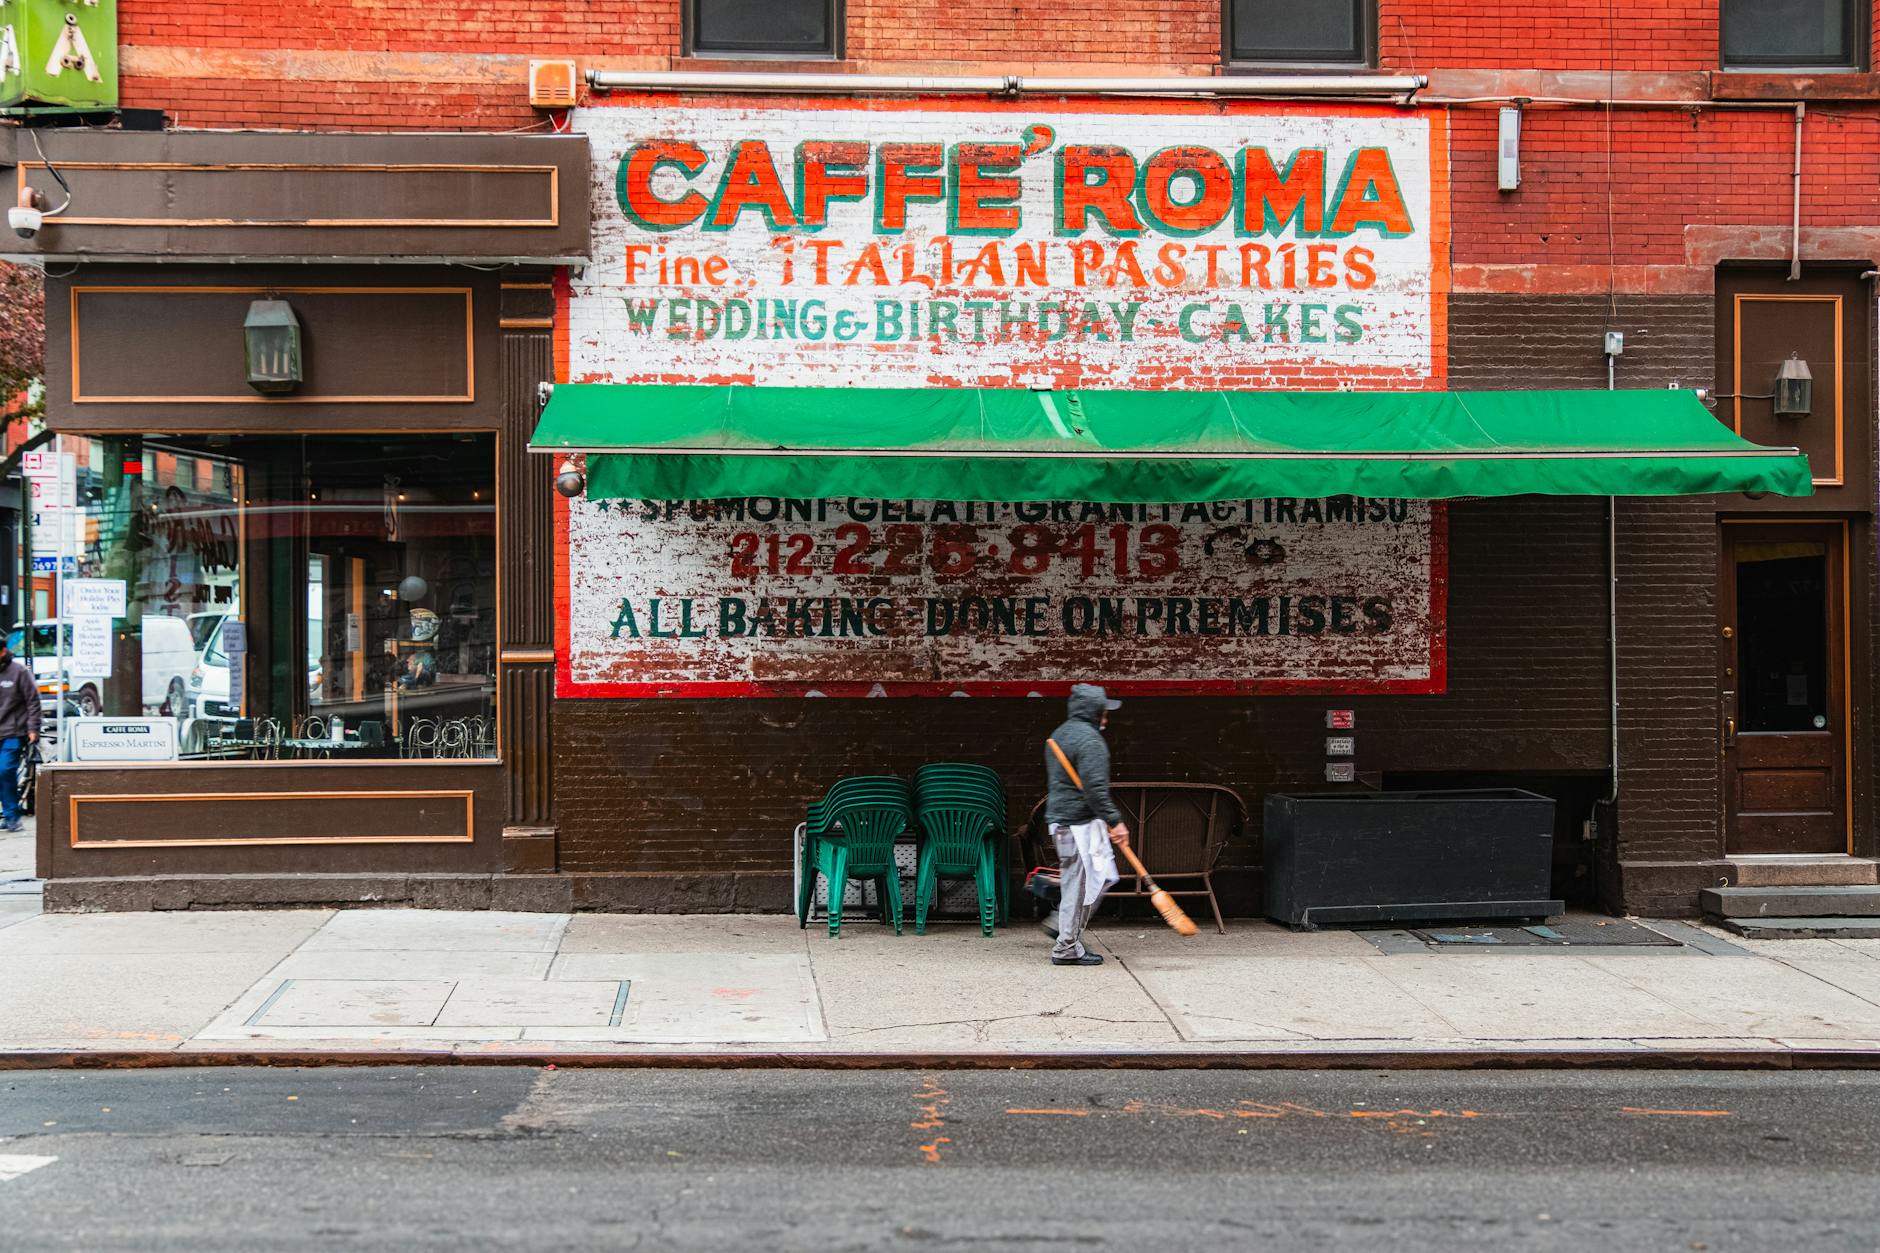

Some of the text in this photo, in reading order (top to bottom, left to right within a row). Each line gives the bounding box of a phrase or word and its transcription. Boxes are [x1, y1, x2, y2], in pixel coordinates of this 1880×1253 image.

[1053, 144, 1416, 239] ROMA
[771, 235, 1050, 290] ITALIAN
[1069, 240, 1377, 290] PASTRIES
[621, 297, 828, 342] WEDDING
[833, 308, 868, 342] &
[873, 299, 1142, 344] BIRTHDAY
[1178, 303, 1363, 344] CAKES
[731, 532, 814, 577] 212
[610, 597, 706, 638] ALL
[925, 598, 1050, 638] DONE
[1061, 597, 1124, 636] ON
[1134, 597, 1394, 636] PREMISES
[82, 739, 167, 748] ESPRESSO MARTINI
